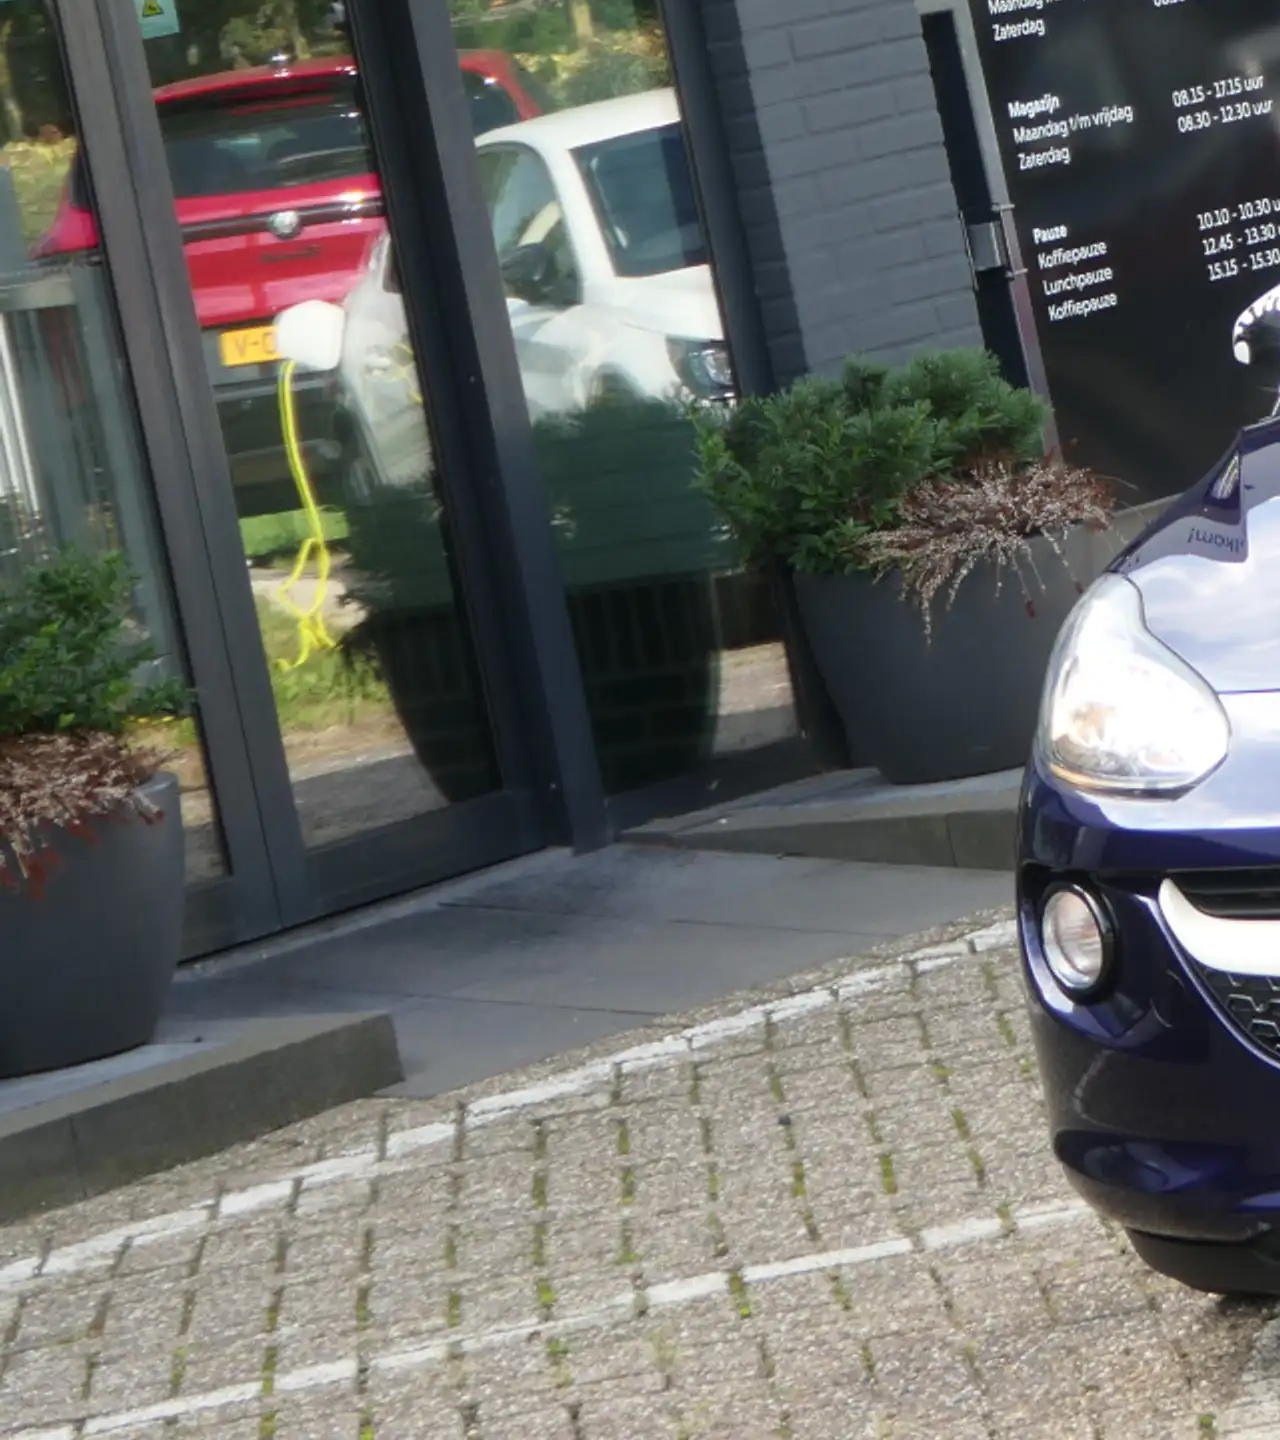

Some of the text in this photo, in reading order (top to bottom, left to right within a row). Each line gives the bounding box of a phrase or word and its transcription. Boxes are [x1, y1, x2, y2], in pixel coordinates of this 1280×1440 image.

[992, 18, 1046, 41] Zaterdag
[1008, 93, 1060, 119] Magazijn
[1012, 120, 1069, 144] Maandag
[1068, 113, 1091, 132] t/m
[1092, 105, 1134, 127] vrijdag
[1172, 85, 1205, 108] 08.15
[1213, 77, 1242, 99] 17.15
[1244, 75, 1264, 91] uur
[1017, 146, 1071, 170] Zaterdag
[1177, 110, 1211, 133] 08.30
[1220, 102, 1251, 123] 12.30
[1252, 100, 1273, 115] uur
[1032, 224, 1067, 245] Pauze
[1038, 241, 1107, 270] Koffiepauze
[1196, 208, 1230, 231] 10.10
[1238, 198, 1271, 220] 10.30
[1042, 267, 1113, 295] Lunchpauze
[1202, 232, 1234, 256] 12.45
[1244, 223, 1275, 245] 13.30
[1048, 293, 1117, 321] Koffiepauze
[1208, 258, 1239, 281] 15.15
[1249, 248, 1280, 270] 15.30
